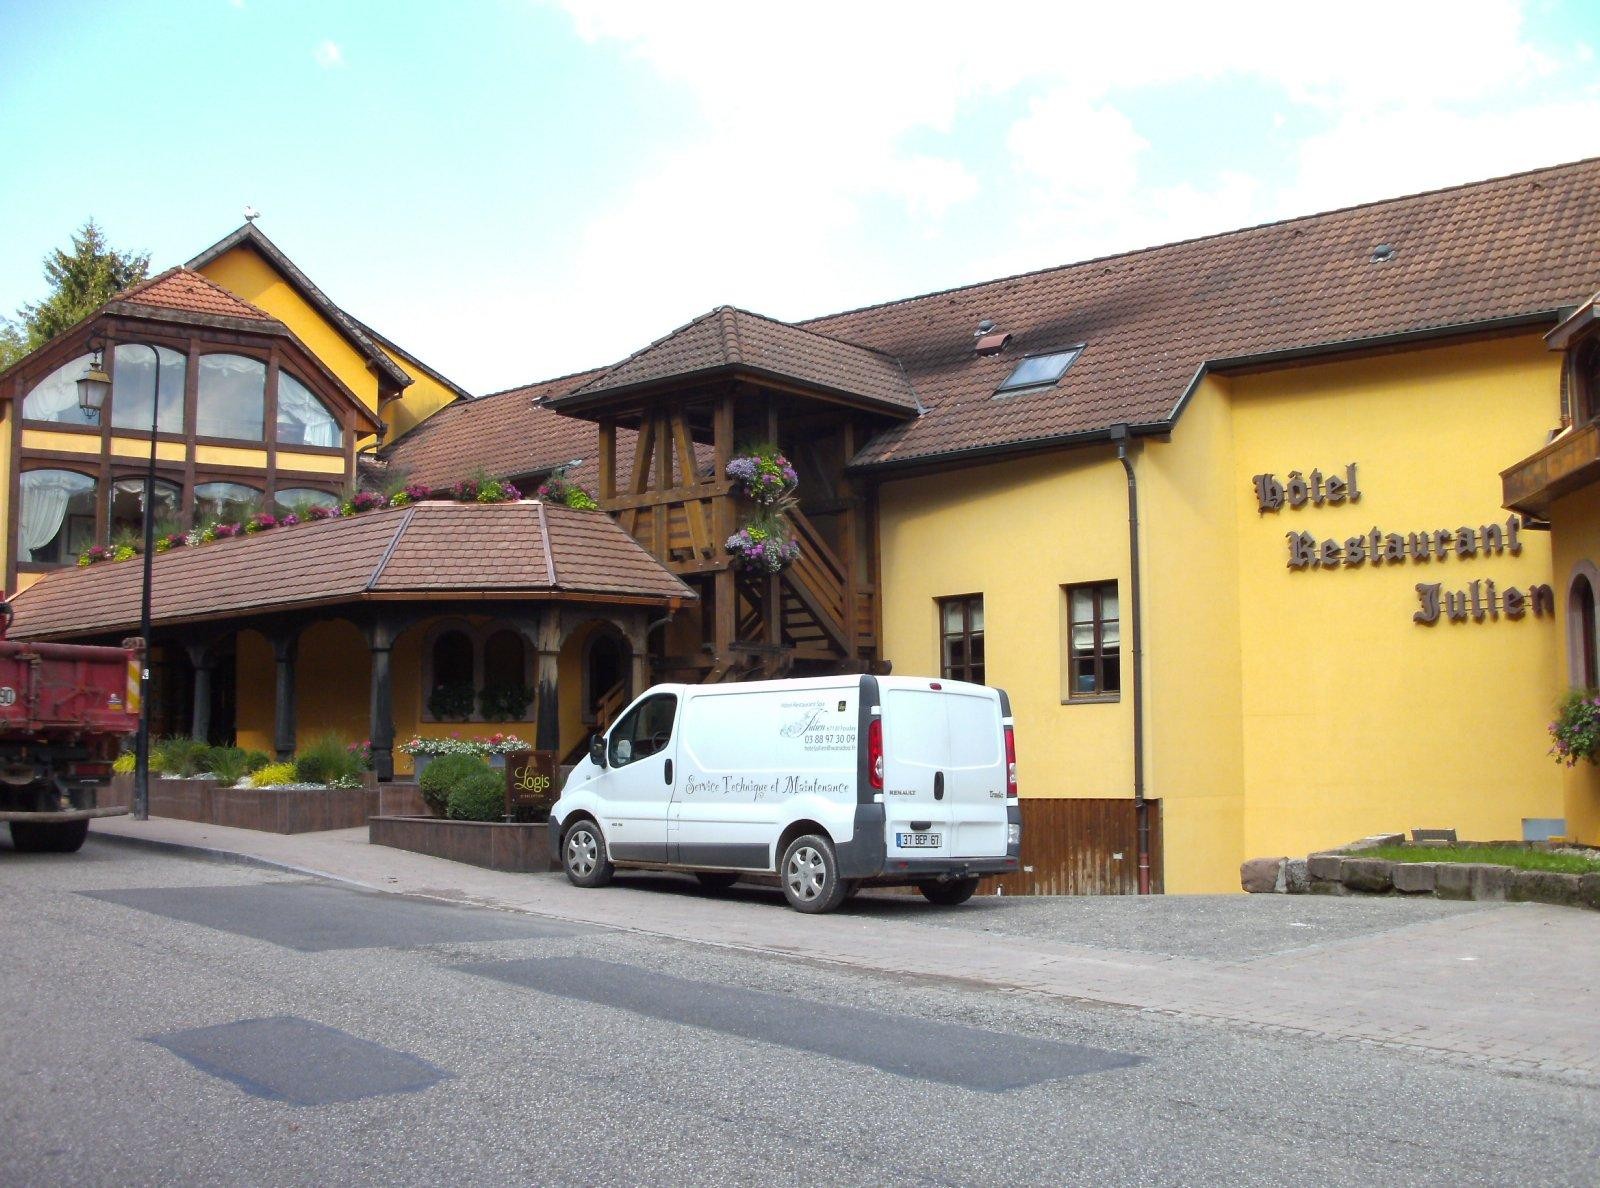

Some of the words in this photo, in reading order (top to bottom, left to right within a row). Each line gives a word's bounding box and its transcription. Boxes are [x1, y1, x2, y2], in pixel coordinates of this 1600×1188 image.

[1286, 513, 1522, 569] Restaurant
[1412, 578, 1555, 626] Julien
[804, 735, 813, 744] 03
[814, 734, 824, 744] 88
[825, 734, 834, 744] 97
[835, 734, 845, 744] 30
[846, 734, 856, 743] 09
[513, 766, 550, 793] Logis
[685, 774, 719, 795] Service
[722, 775, 768, 802] Technique
[770, 778, 779, 793] et
[782, 775, 849, 794] Maintenance
[903, 834, 912, 845] 37
[915, 834, 928, 845] BEP
[930, 834, 939, 845] 67
